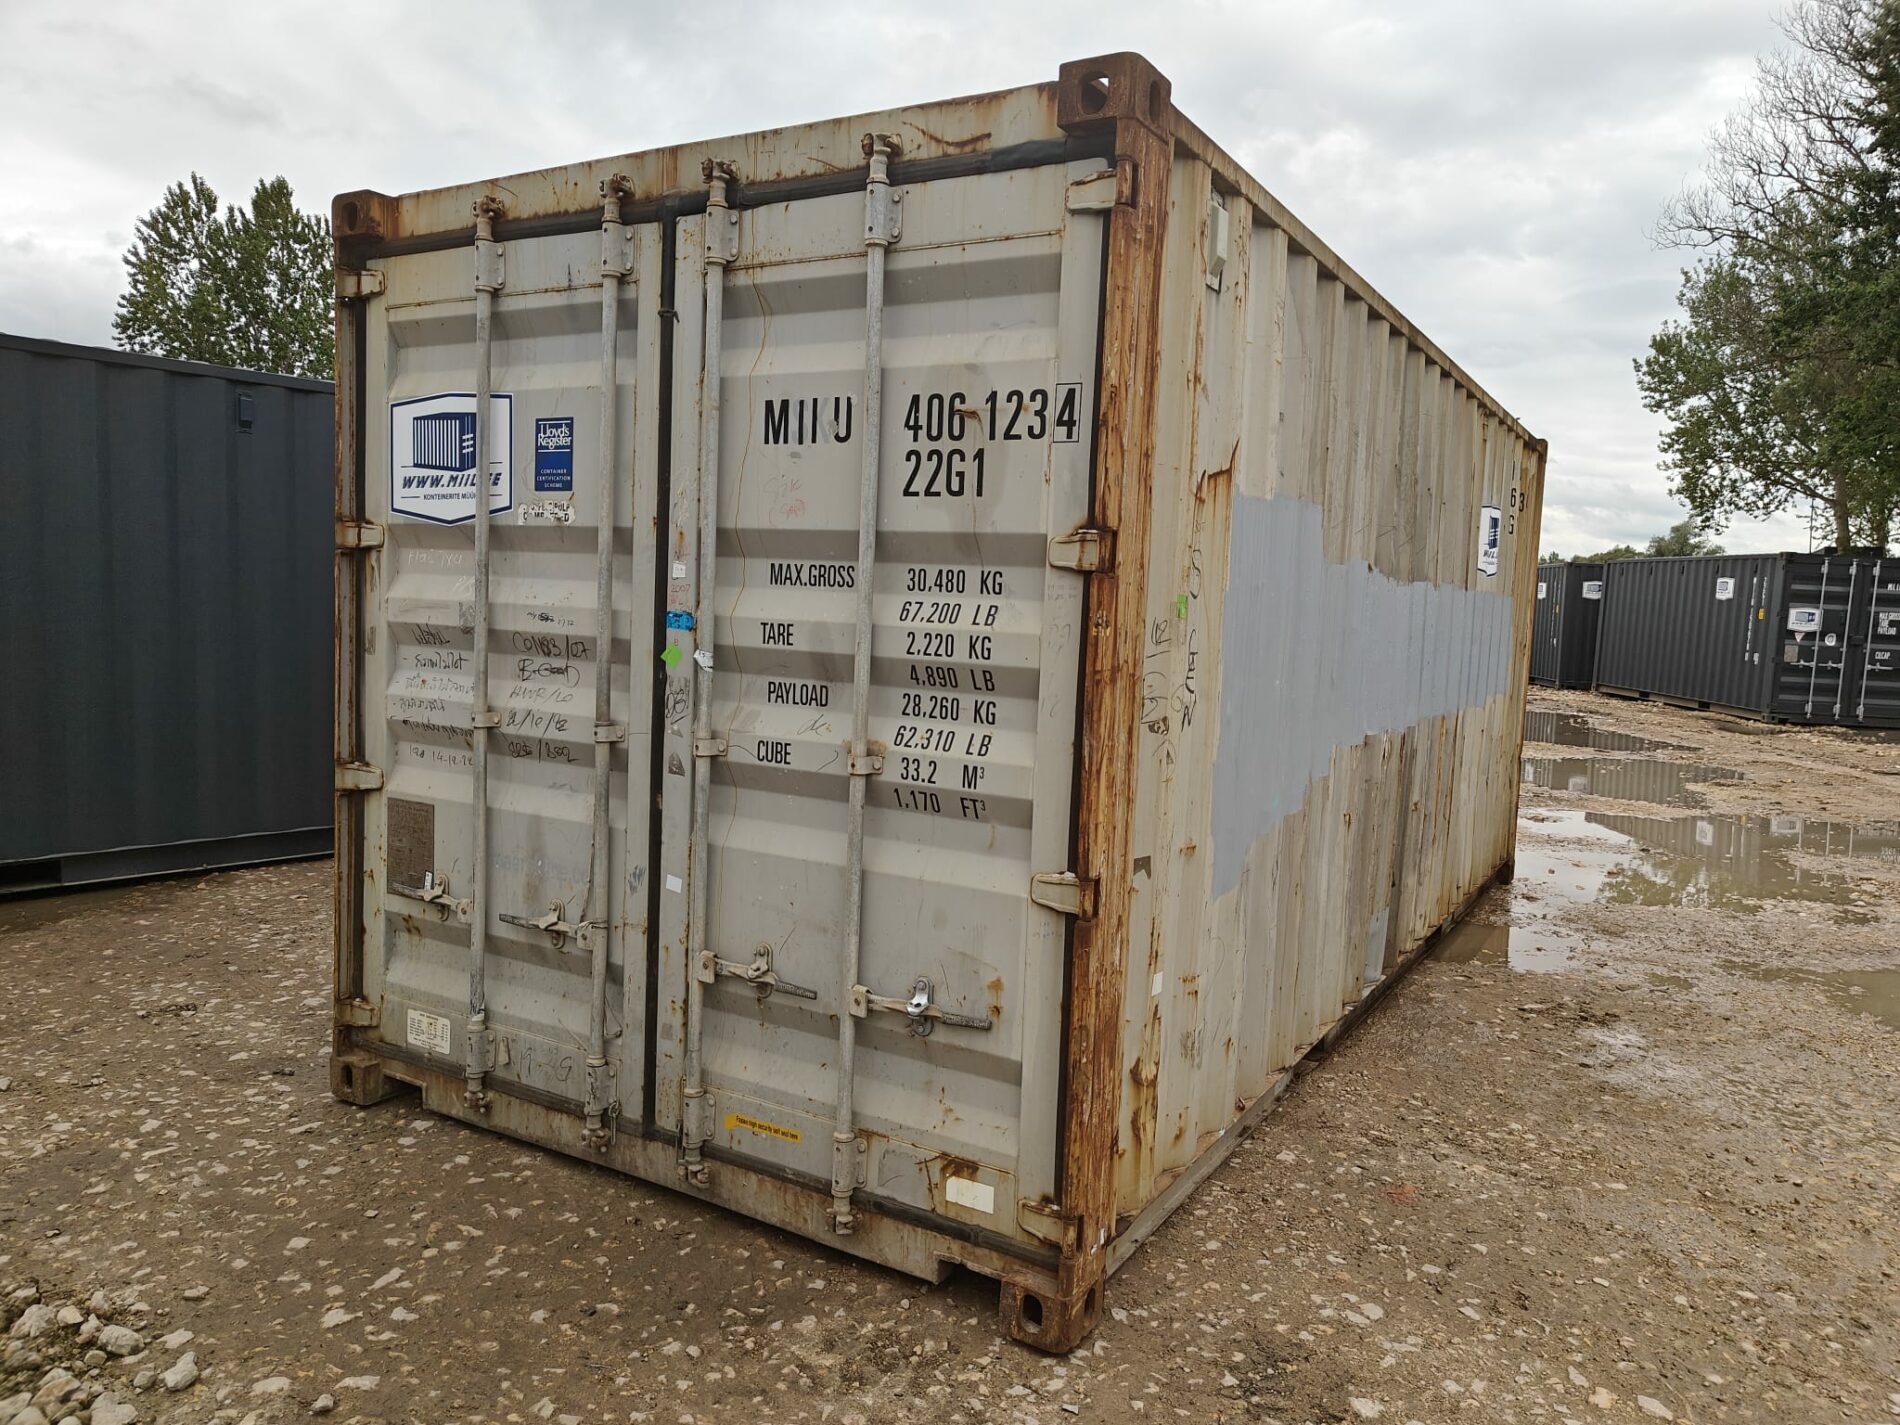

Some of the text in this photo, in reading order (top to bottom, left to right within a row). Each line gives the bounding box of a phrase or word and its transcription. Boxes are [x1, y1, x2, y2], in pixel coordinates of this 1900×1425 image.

[764, 387, 1077, 445] MIIU 406 123 4
[537, 433, 572, 449] Register
[902, 447, 985, 498] 22G1
[423, 493, 461, 501] KONTEINERITE
[769, 562, 855, 588] MAX.GROSS
[980, 570, 1003, 596] KG
[971, 604, 999, 626] LB
[760, 622, 794, 647] TARE
[969, 635, 992, 660] KG
[970, 668, 995, 692] LB
[767, 681, 829, 708] PAYLOAD
[974, 698, 997, 725] KG
[757, 740, 792, 766] CUBE
[900, 757, 937, 784] 33.2
[965, 733, 992, 757] LB
